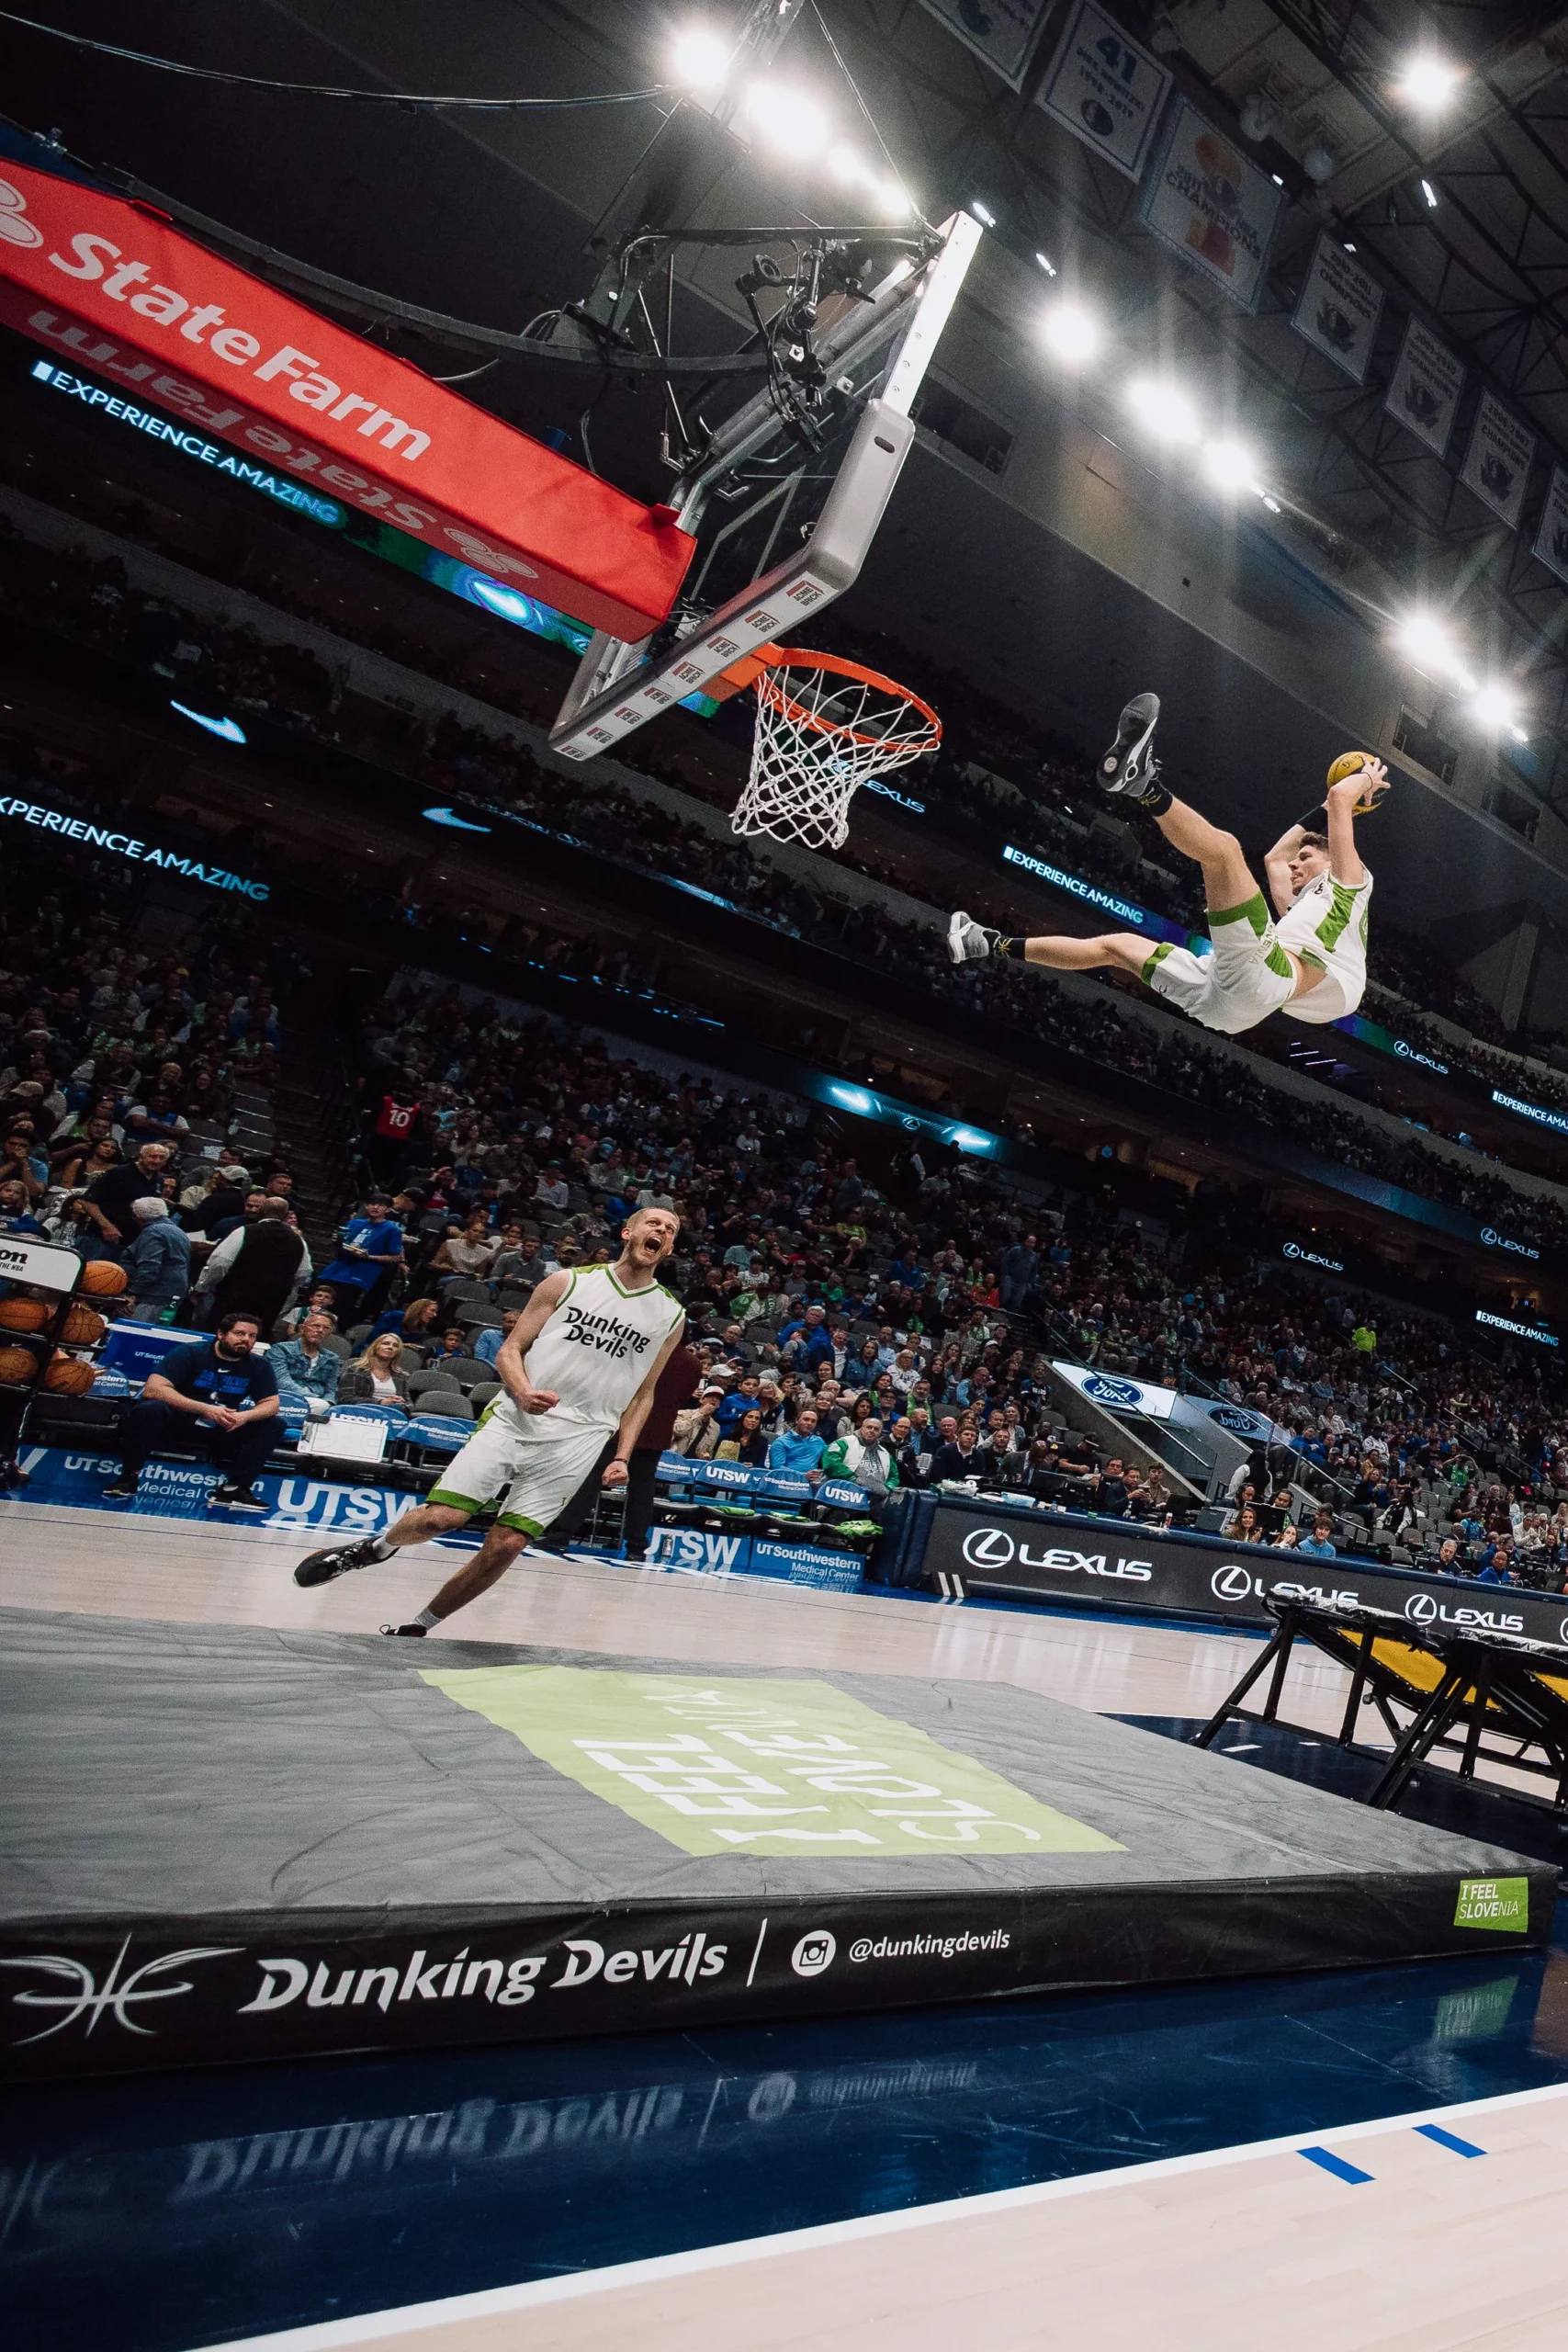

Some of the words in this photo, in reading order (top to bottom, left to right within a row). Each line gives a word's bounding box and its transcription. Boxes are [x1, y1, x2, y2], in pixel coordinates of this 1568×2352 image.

[1096, 35, 1137, 85] 41
[51, 372, 220, 464] EXPERIENCE
[218, 456, 341, 525] AMAZING
[793, 587, 815, 602] ACME
[143, 849, 270, 900] AMAZING
[1012, 851, 1089, 897] EXPERIENCE
[1086, 888, 1145, 924] AMAZING
[1409, 1049, 1450, 1075] LEXUS
[389, 1109, 410, 1127] 10
[1498, 1093, 1547, 1122] EXPERIENCE
[1300, 1250, 1344, 1272] LEXUS
[1497, 1236, 1540, 1260] LEXUS
[562, 1306, 651, 1354] Dunking
[562, 1324, 628, 1359] Devils
[1481, 1313, 1527, 1336] EXPERIENCE
[1524, 1327, 1560, 1348] AMAZING
[705, 1465, 751, 1484] UTSW
[824, 1486, 865, 1505] UTSW
[791, 1562, 828, 1577] Medical
[829, 1568, 860, 1581] Center
[1019, 1544, 1153, 1582] LEXUS
[1439, 1603, 1525, 1633] LEXUS
[571, 1733, 830, 1816] FEEL
[643, 1689, 1043, 1843] SLOVENIA
[1461, 1884, 1469, 1901] I
[1470, 1883, 1499, 1901] FEEL
[1459, 1900, 1520, 1919] SLOVENIA
[849, 1928, 1011, 1962] @dunkingdevils
[237, 1946, 547, 2014] Dunking
[549, 1932, 728, 1989] Devils
